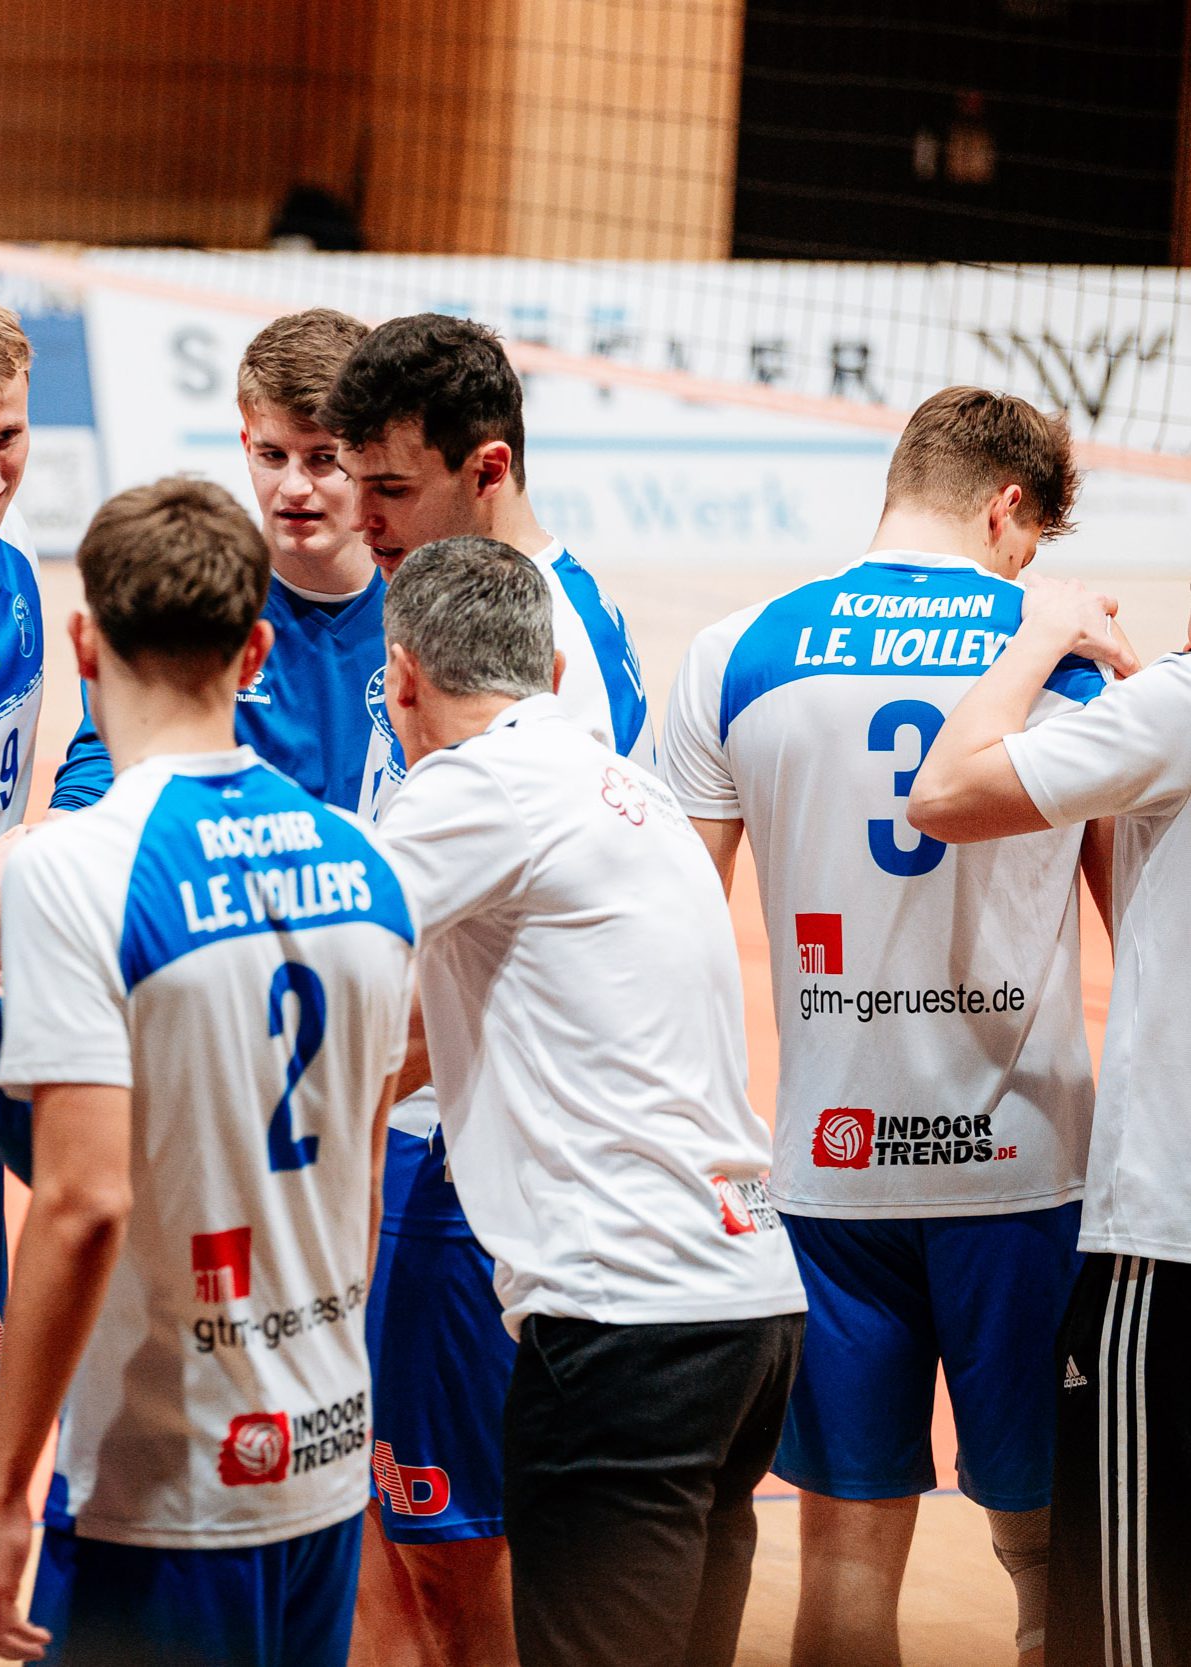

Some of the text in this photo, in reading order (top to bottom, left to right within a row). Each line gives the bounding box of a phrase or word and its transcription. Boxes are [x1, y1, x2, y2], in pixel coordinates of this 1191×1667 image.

[794, 627, 1015, 667] L.E. VOLLEY
[0, 727, 19, 811] 9
[868, 699, 947, 877] 3
[179, 859, 373, 933] L.E. VOLLEYS
[800, 980, 1025, 1024] gtm-gerueste.de
[267, 960, 327, 1173] 2
[877, 1113, 993, 1140] INDOOR
[292, 1391, 365, 1442] INDOOR
